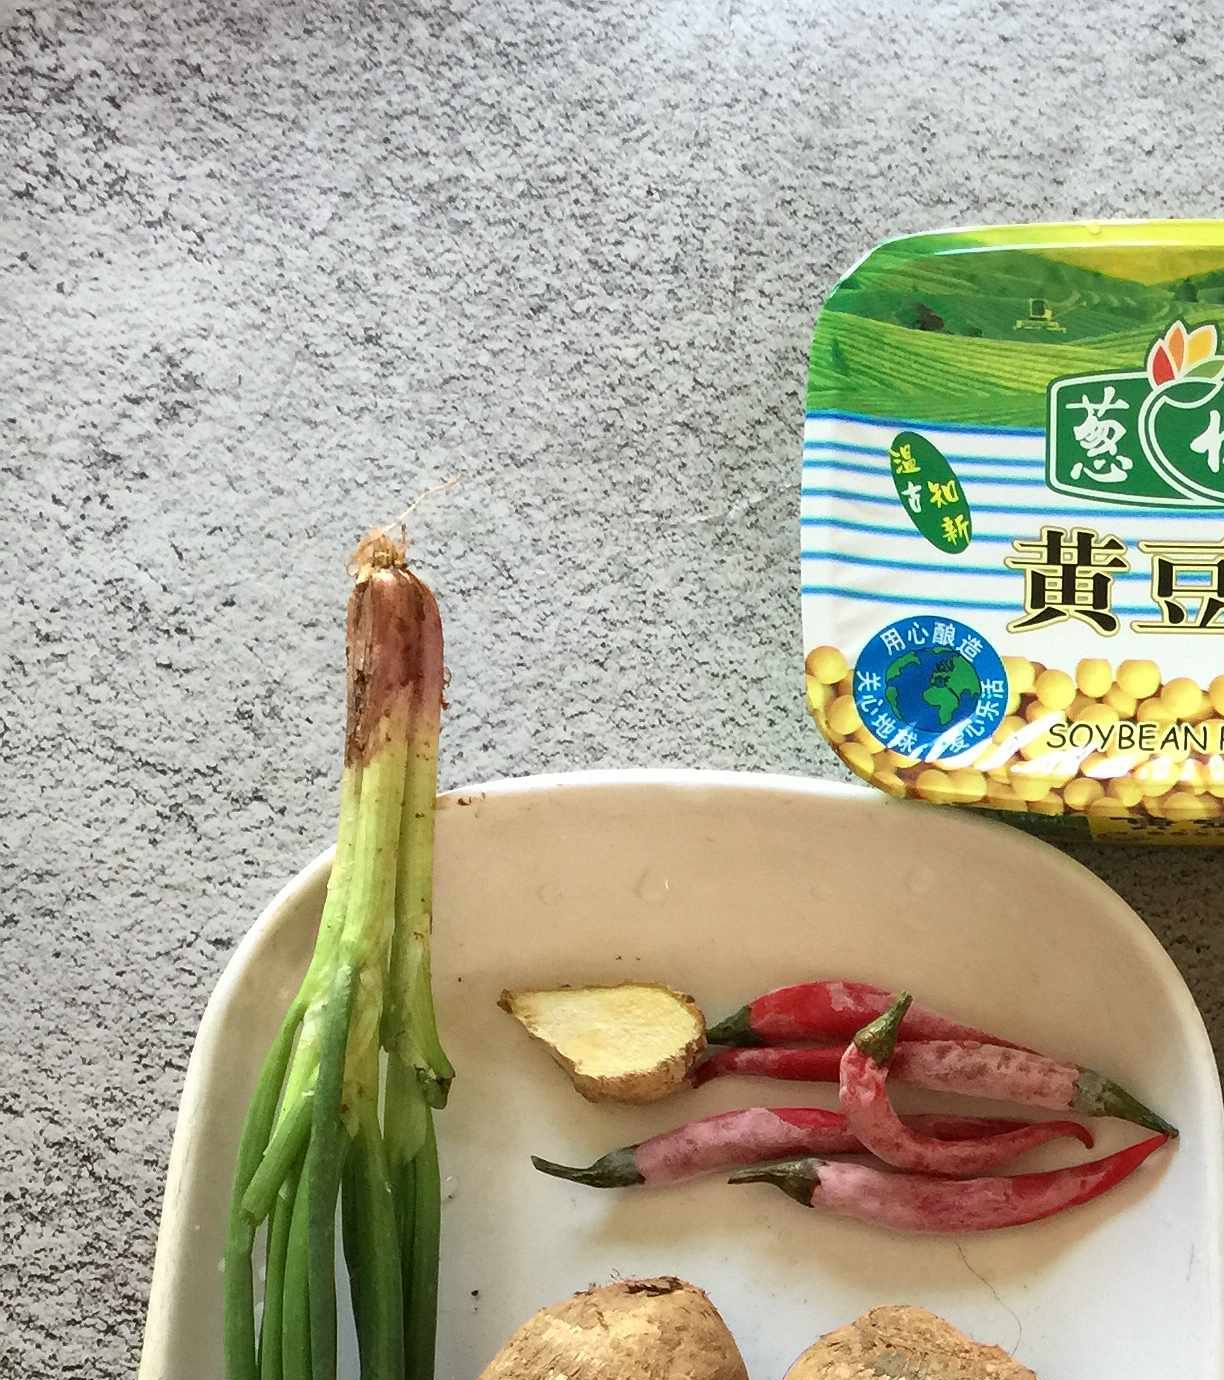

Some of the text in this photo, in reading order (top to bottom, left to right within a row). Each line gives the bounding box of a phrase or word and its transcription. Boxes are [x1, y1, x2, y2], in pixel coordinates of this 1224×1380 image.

[880, 621, 984, 663] 用心酿造
[1046, 723, 1208, 752] SOYBEAN
